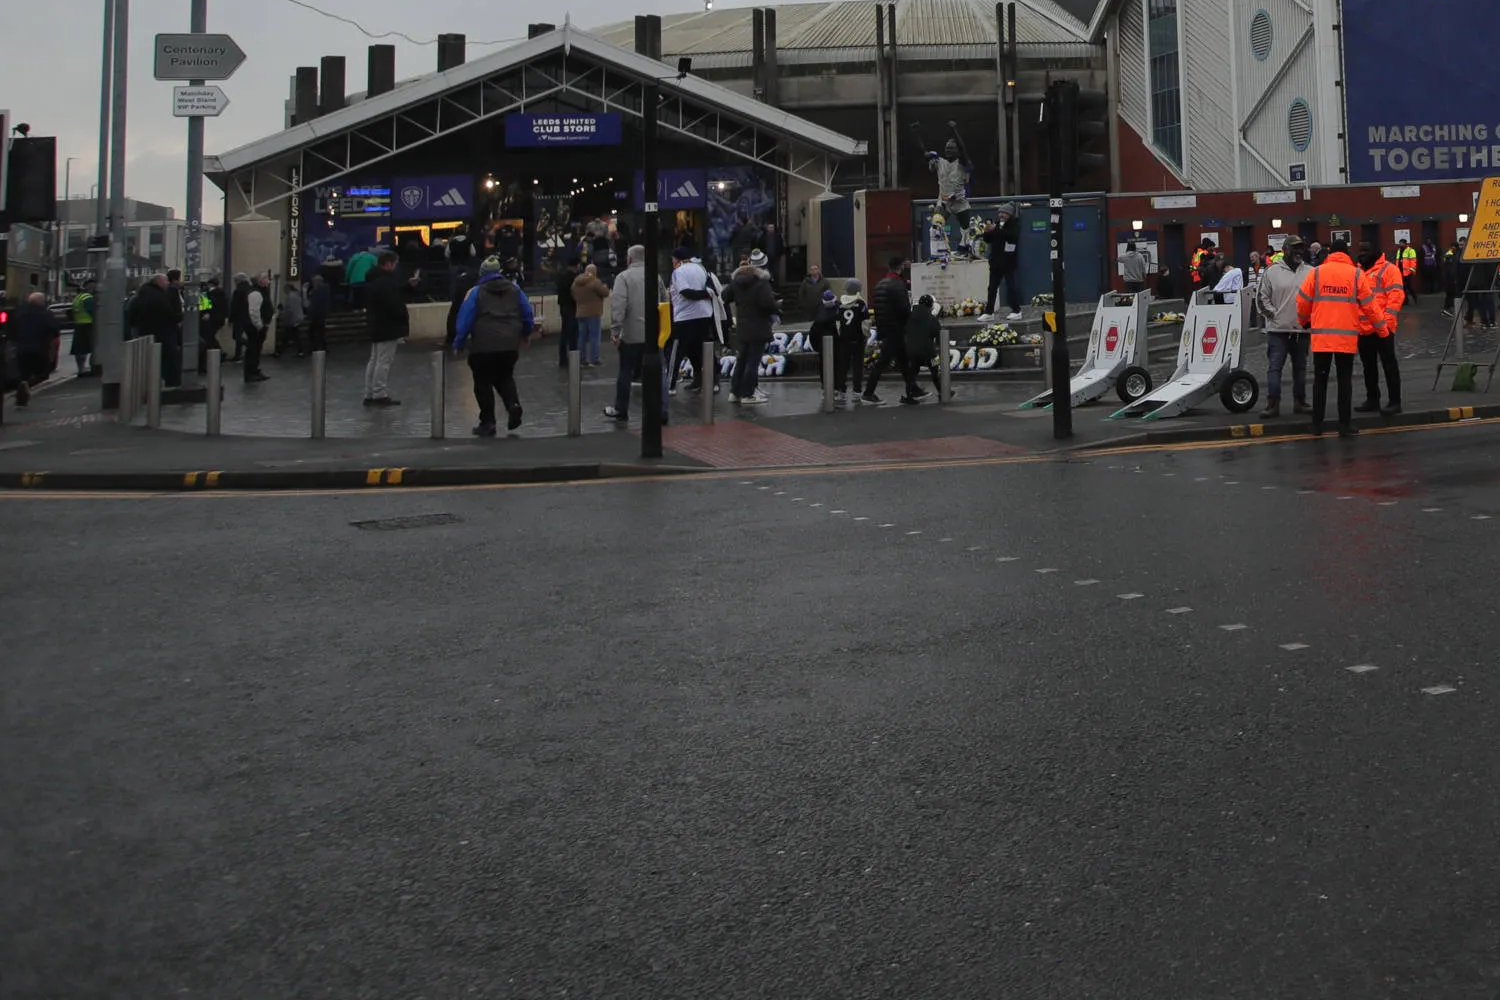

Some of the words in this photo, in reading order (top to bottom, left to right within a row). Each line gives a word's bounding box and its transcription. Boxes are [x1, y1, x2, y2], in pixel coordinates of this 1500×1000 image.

[163, 45, 226, 56] Centenary
[170, 57, 218, 66] Pavilion
[532, 118, 560, 126] LEEDS
[563, 118, 597, 126] UNITED
[532, 126, 560, 134] CLUB
[563, 125, 597, 133] STORE
[1368, 124, 1489, 143] MARCHING
[1482, 223, 1500, 231] AND
[1473, 240, 1497, 249] WHEN
[843, 309, 855, 325] 9
